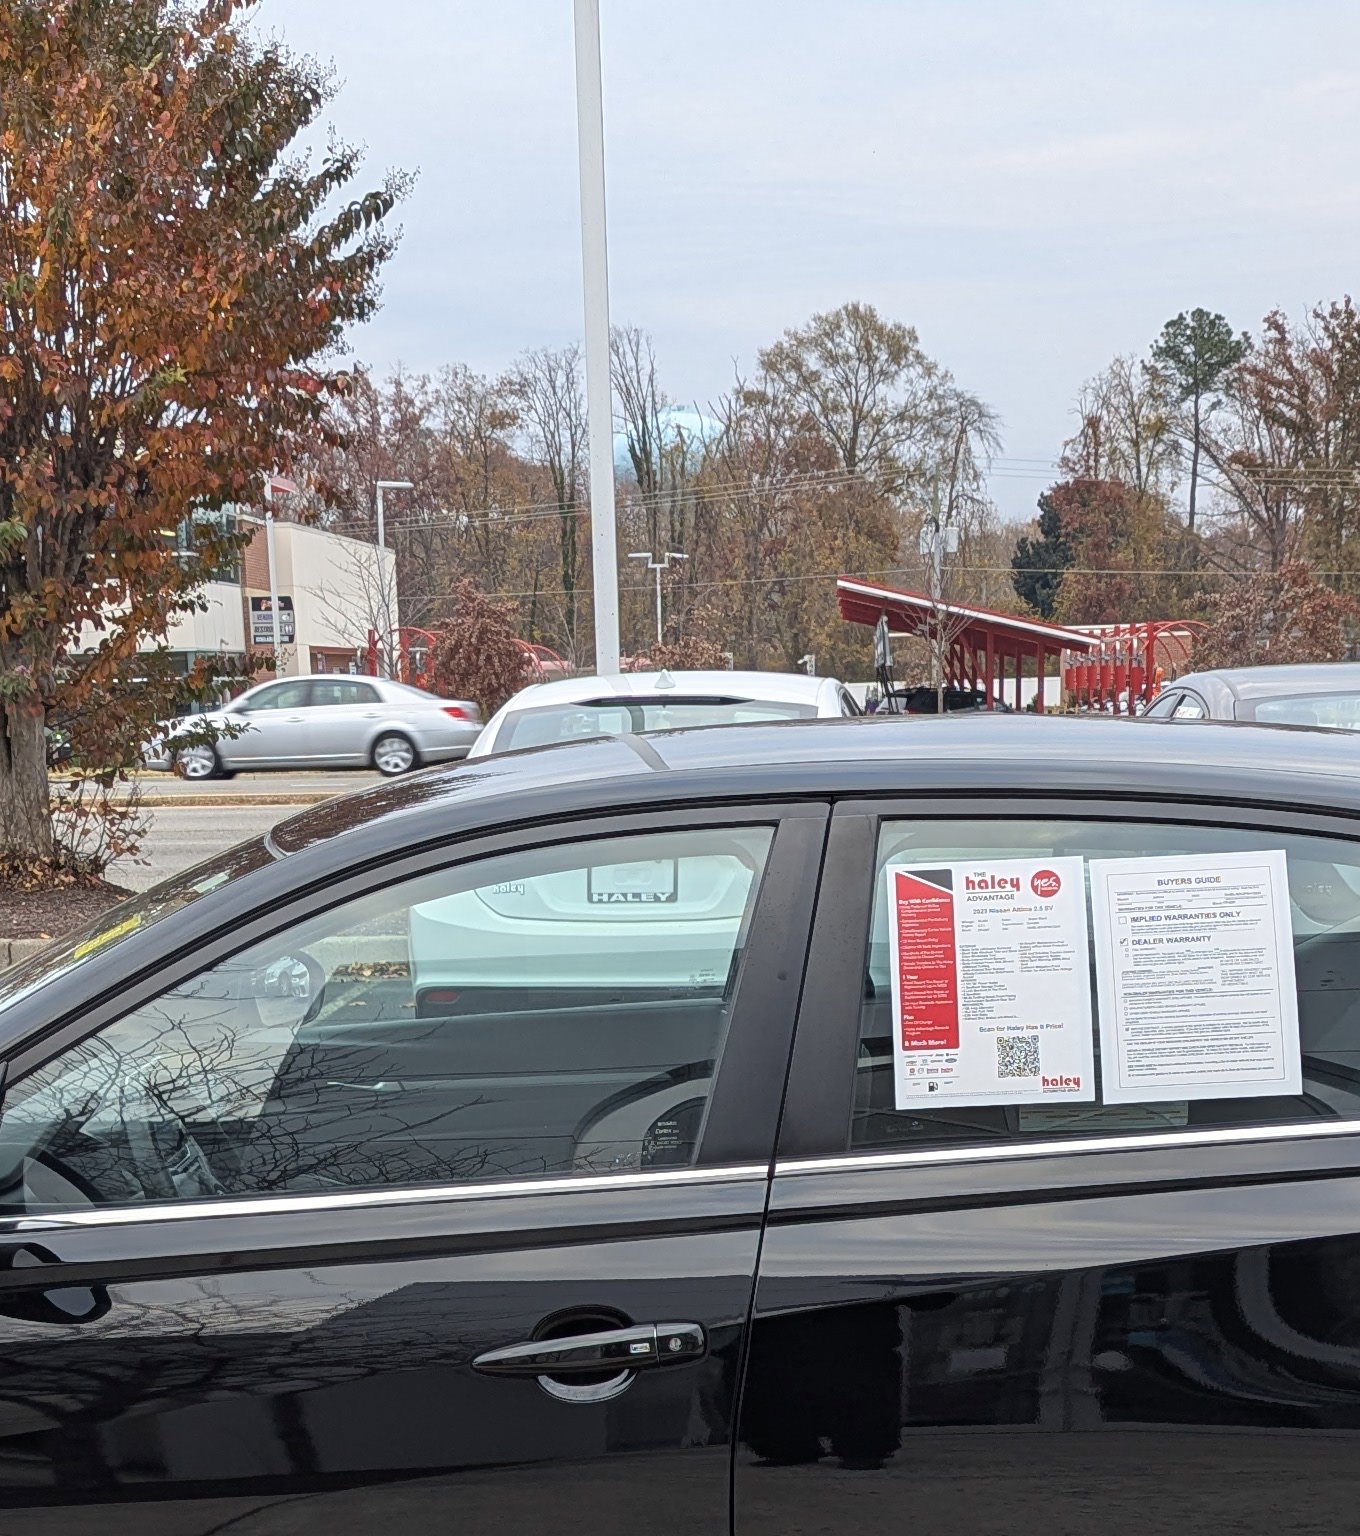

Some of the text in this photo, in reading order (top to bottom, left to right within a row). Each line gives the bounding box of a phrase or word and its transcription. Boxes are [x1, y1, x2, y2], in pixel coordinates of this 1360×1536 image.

[965, 874, 1021, 892] haley
[1157, 875, 1222, 887] BUYERS GUIDE
[592, 891, 672, 903] HALEY
[966, 893, 1015, 902] ADVANTAGE
[1130, 911, 1241, 924] IMPLIED WARRANTIES ONLY
[1131, 935, 1212, 946] DEALER WARRANTY
[1042, 1075, 1081, 1088] haley
